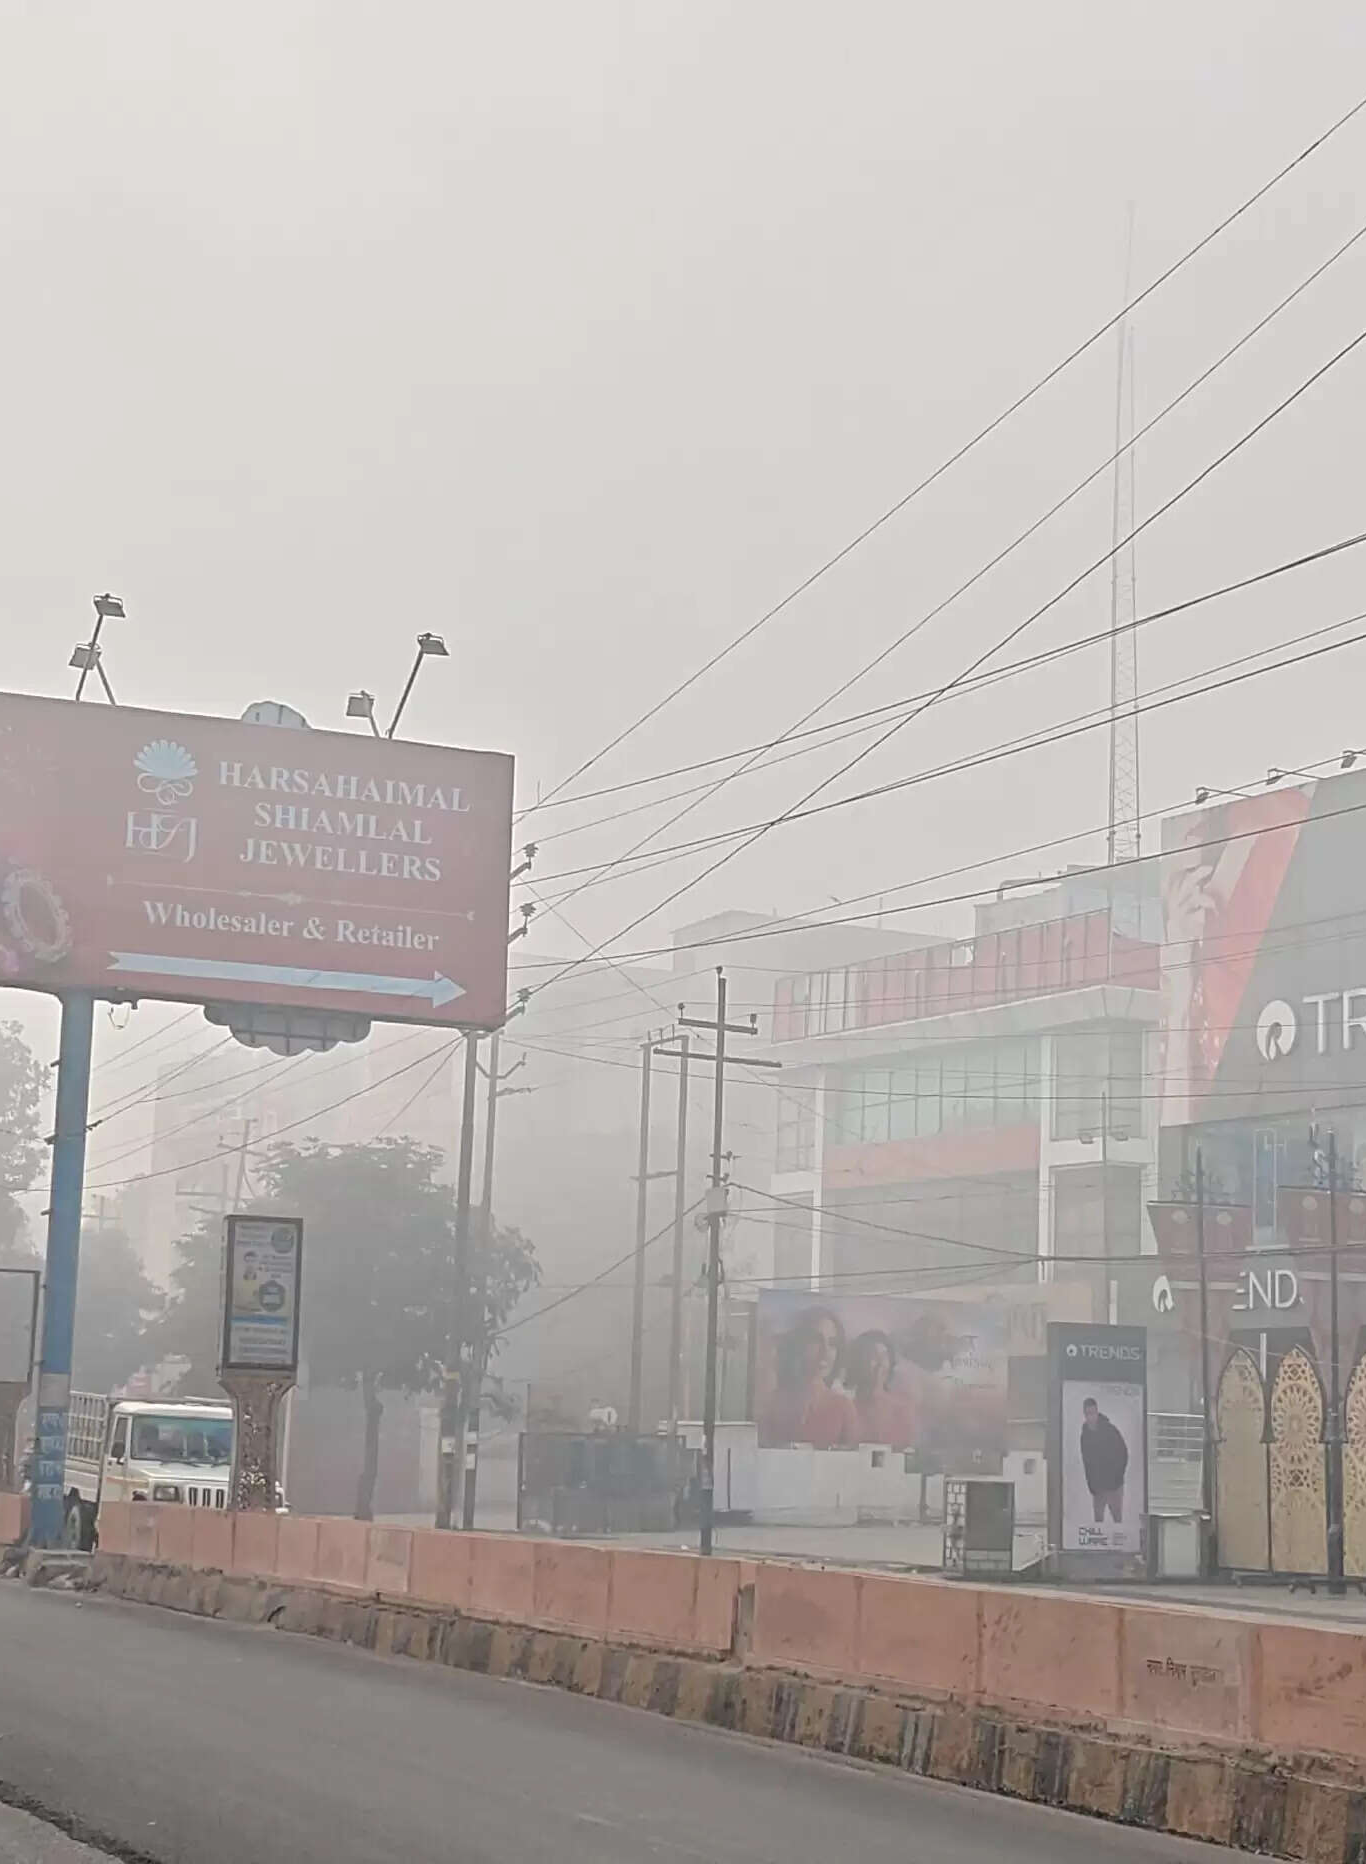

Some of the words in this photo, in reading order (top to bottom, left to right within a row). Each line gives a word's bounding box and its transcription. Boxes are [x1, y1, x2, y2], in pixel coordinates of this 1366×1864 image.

[218, 760, 472, 813] HARSAHAIMAL
[253, 802, 434, 845] SHIAMLAL
[238, 838, 442, 882] JEWELLERS
[143, 900, 295, 938] Wholesaler
[302, 917, 325, 941] &
[335, 919, 439, 952] Retailer
[1080, 1344, 1140, 1361] TRENDS
